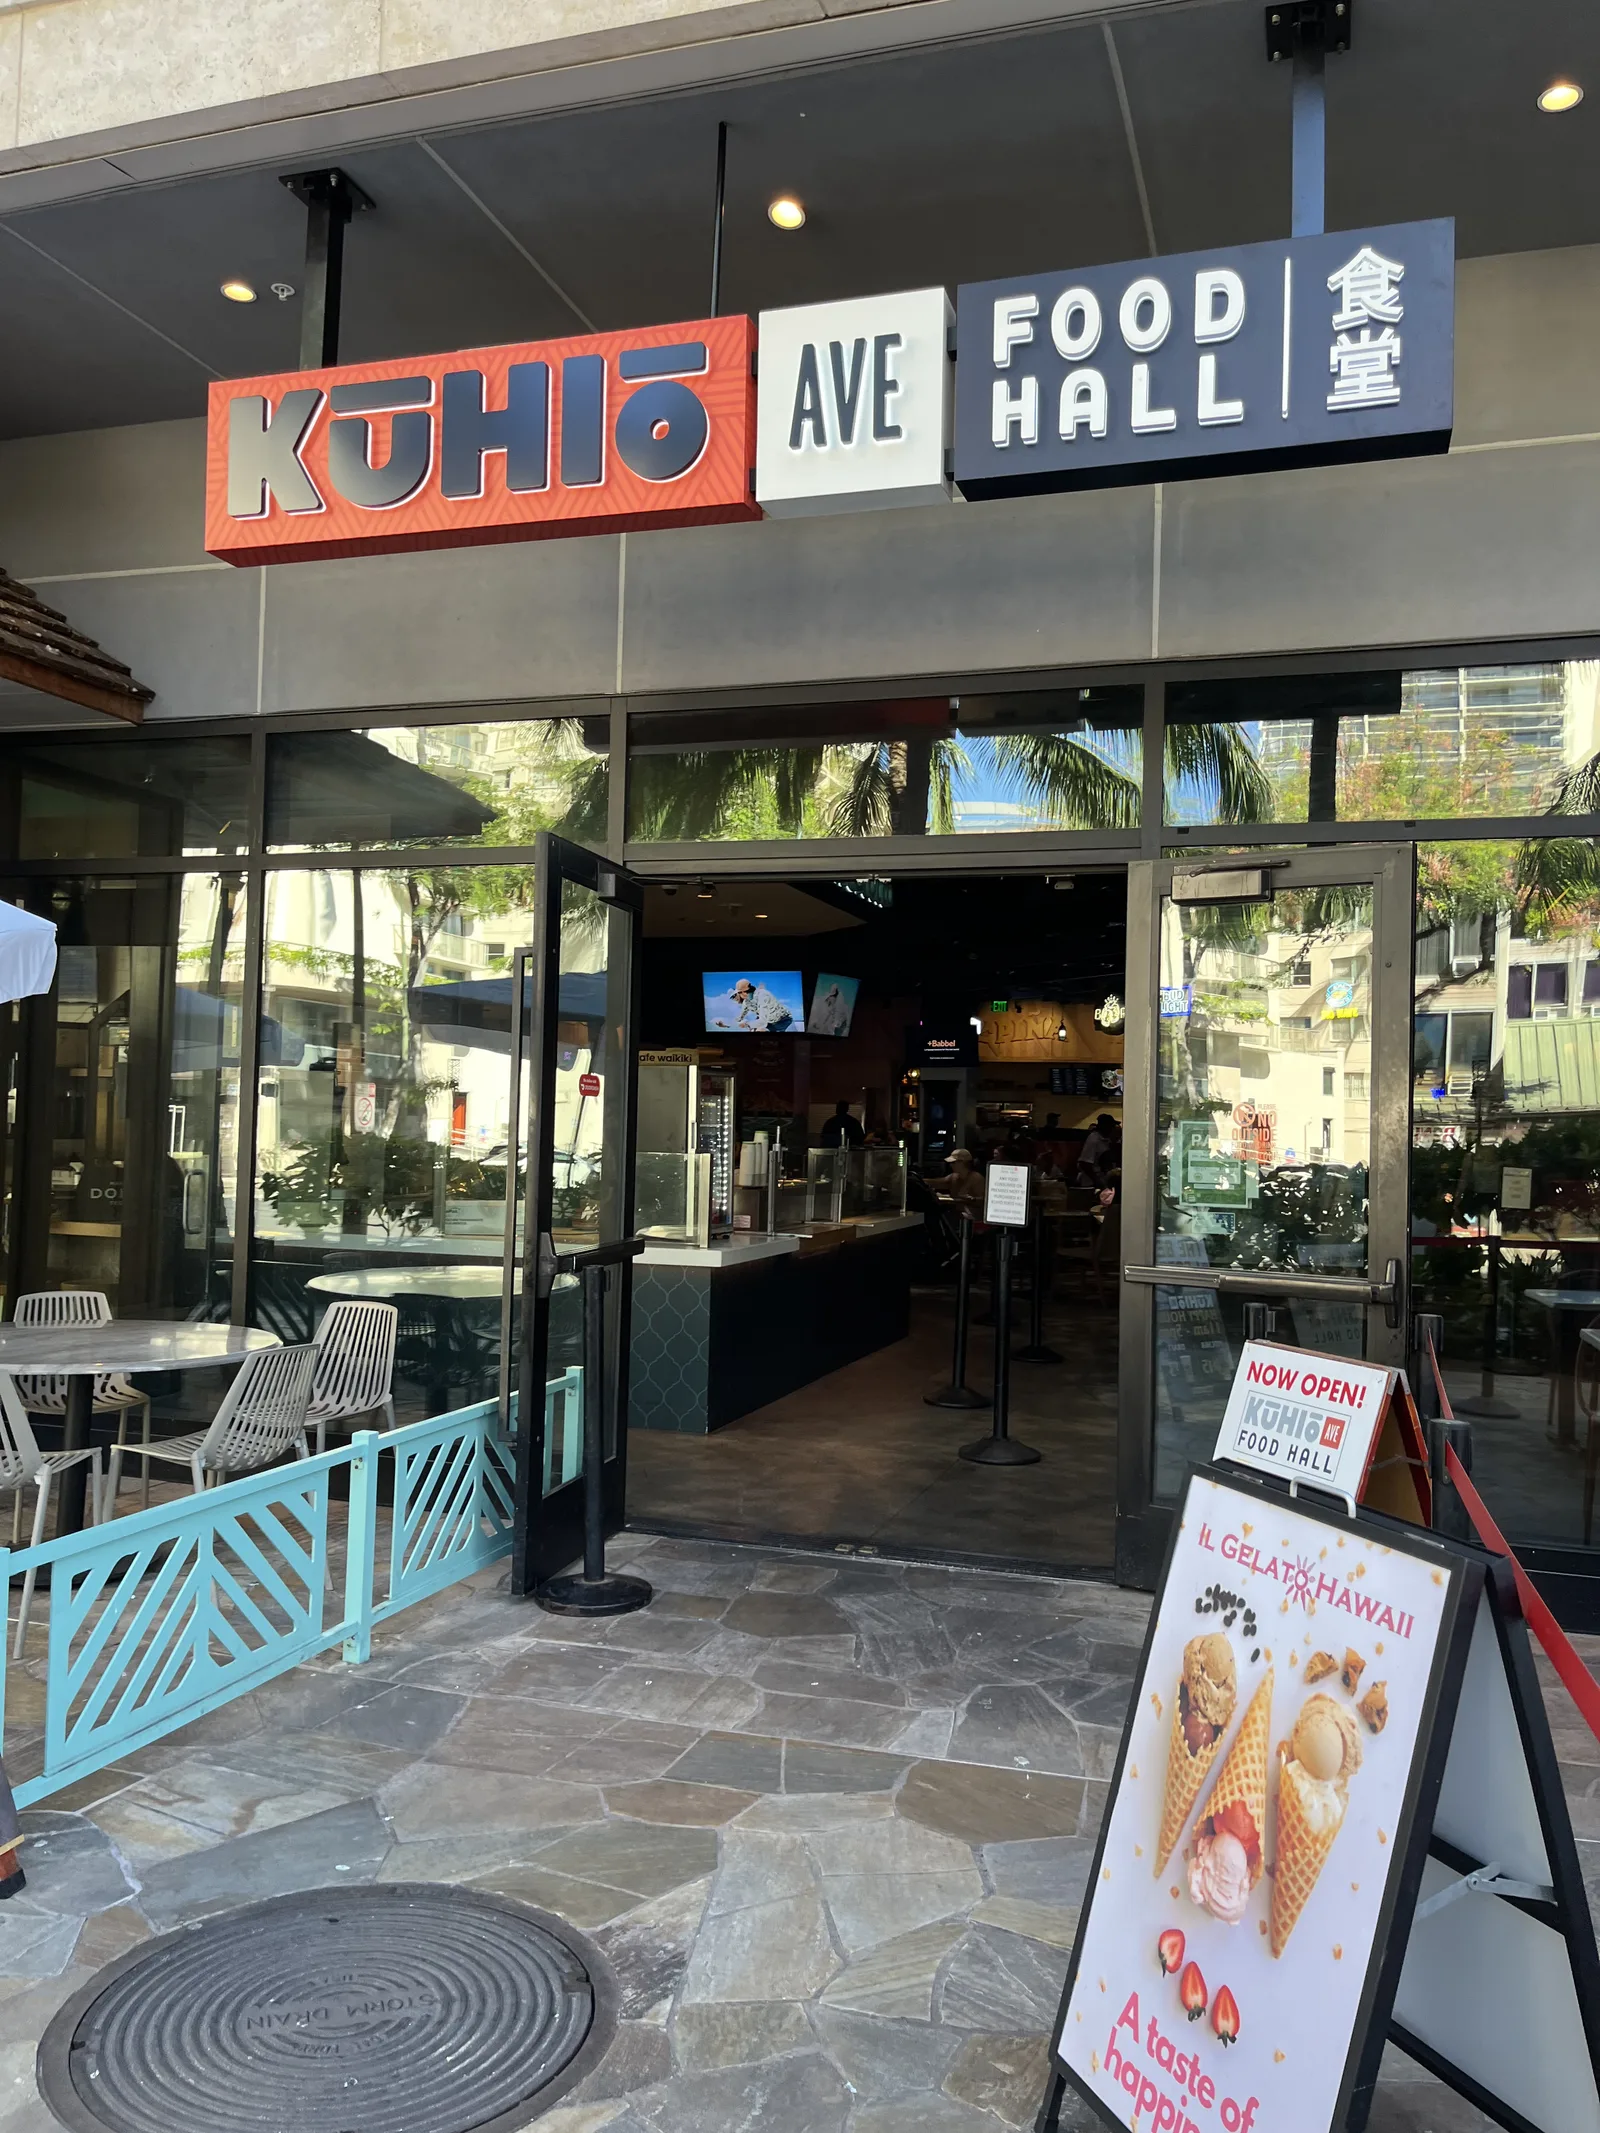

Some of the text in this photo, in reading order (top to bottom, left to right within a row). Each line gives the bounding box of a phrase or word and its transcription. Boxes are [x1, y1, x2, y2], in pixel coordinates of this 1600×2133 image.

[993, 270, 1245, 369] FOOD
[1326, 247, 1404, 412] 食堂
[789, 334, 903, 450] AVE
[991, 355, 1244, 448] HALL
[992, 1001, 1007, 1012] EXIT
[639, 1053, 692, 1062] afe waikiki
[1232, 1128, 1277, 1142] OUTSIDE
[1258, 1111, 1277, 1127] NO
[1246, 1361, 1368, 1409] NOW OPEN!
[1238, 1430, 1333, 1474] FOOD HALL
[1324, 1423, 1340, 1442] AVE
[1198, 1523, 1415, 1640] IL GELATO HAWAII
[246, 1993, 435, 2030] STORM DRAIN
[1116, 1991, 1260, 2133] A taste of
